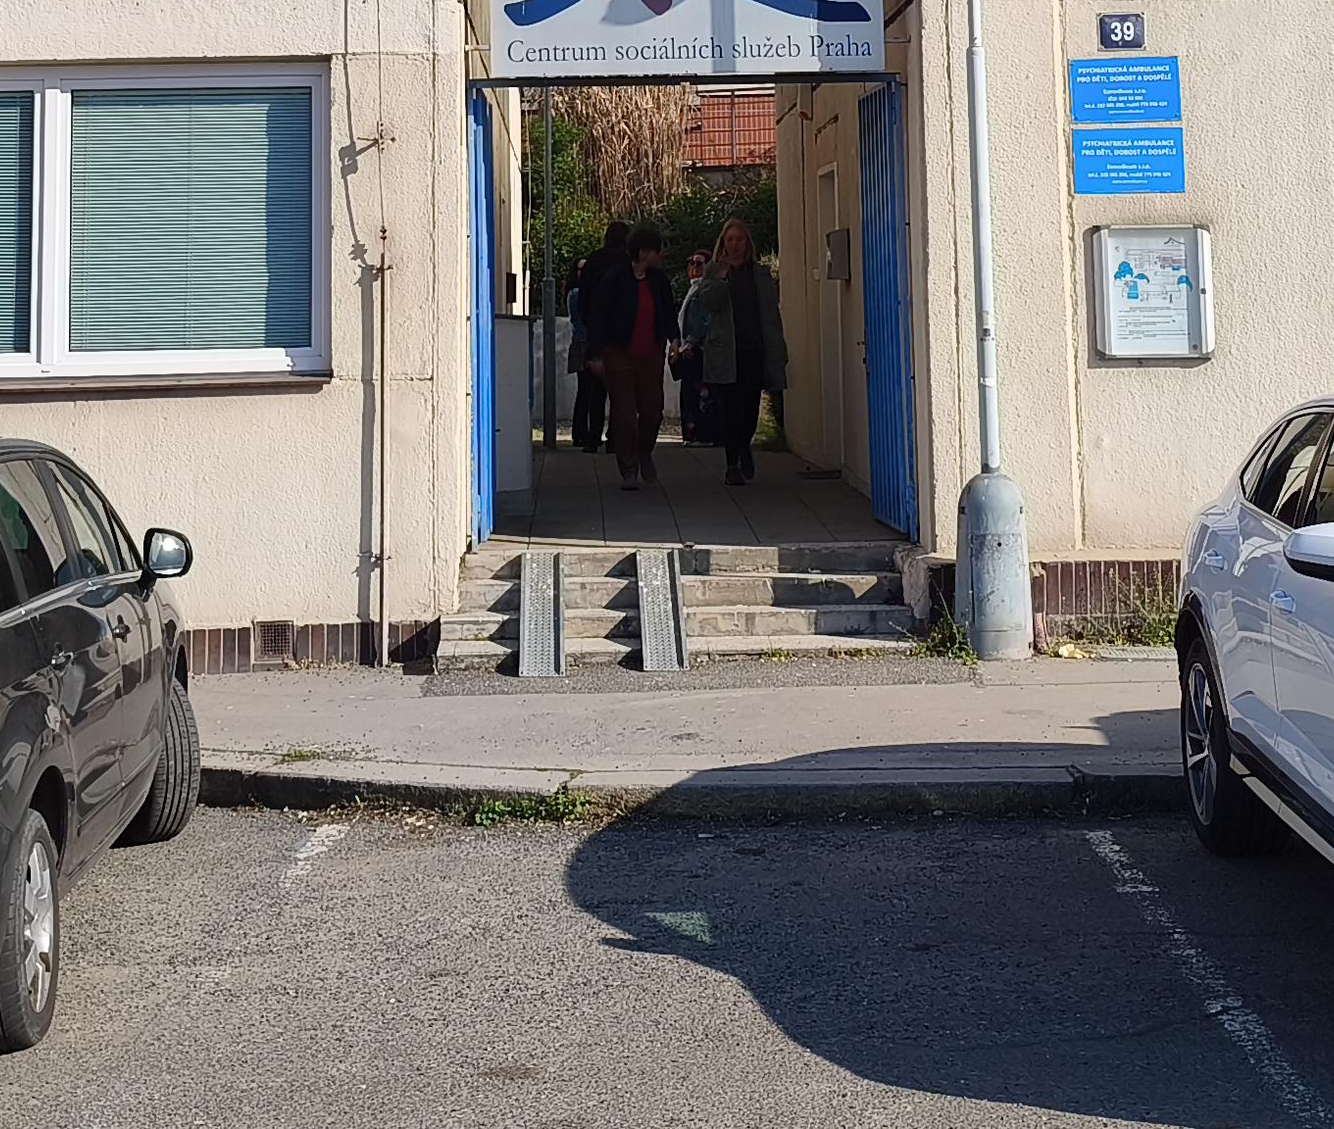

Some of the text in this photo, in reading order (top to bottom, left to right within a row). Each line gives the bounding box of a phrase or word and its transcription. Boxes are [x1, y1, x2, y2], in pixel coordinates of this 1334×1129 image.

[1110, 21, 1135, 41] 39
[507, 34, 872, 64] Centrum sociálních služeb Praha
[1129, 64, 1170, 73] AMBULANCE
[1133, 139, 1175, 147] AMBULANCE
